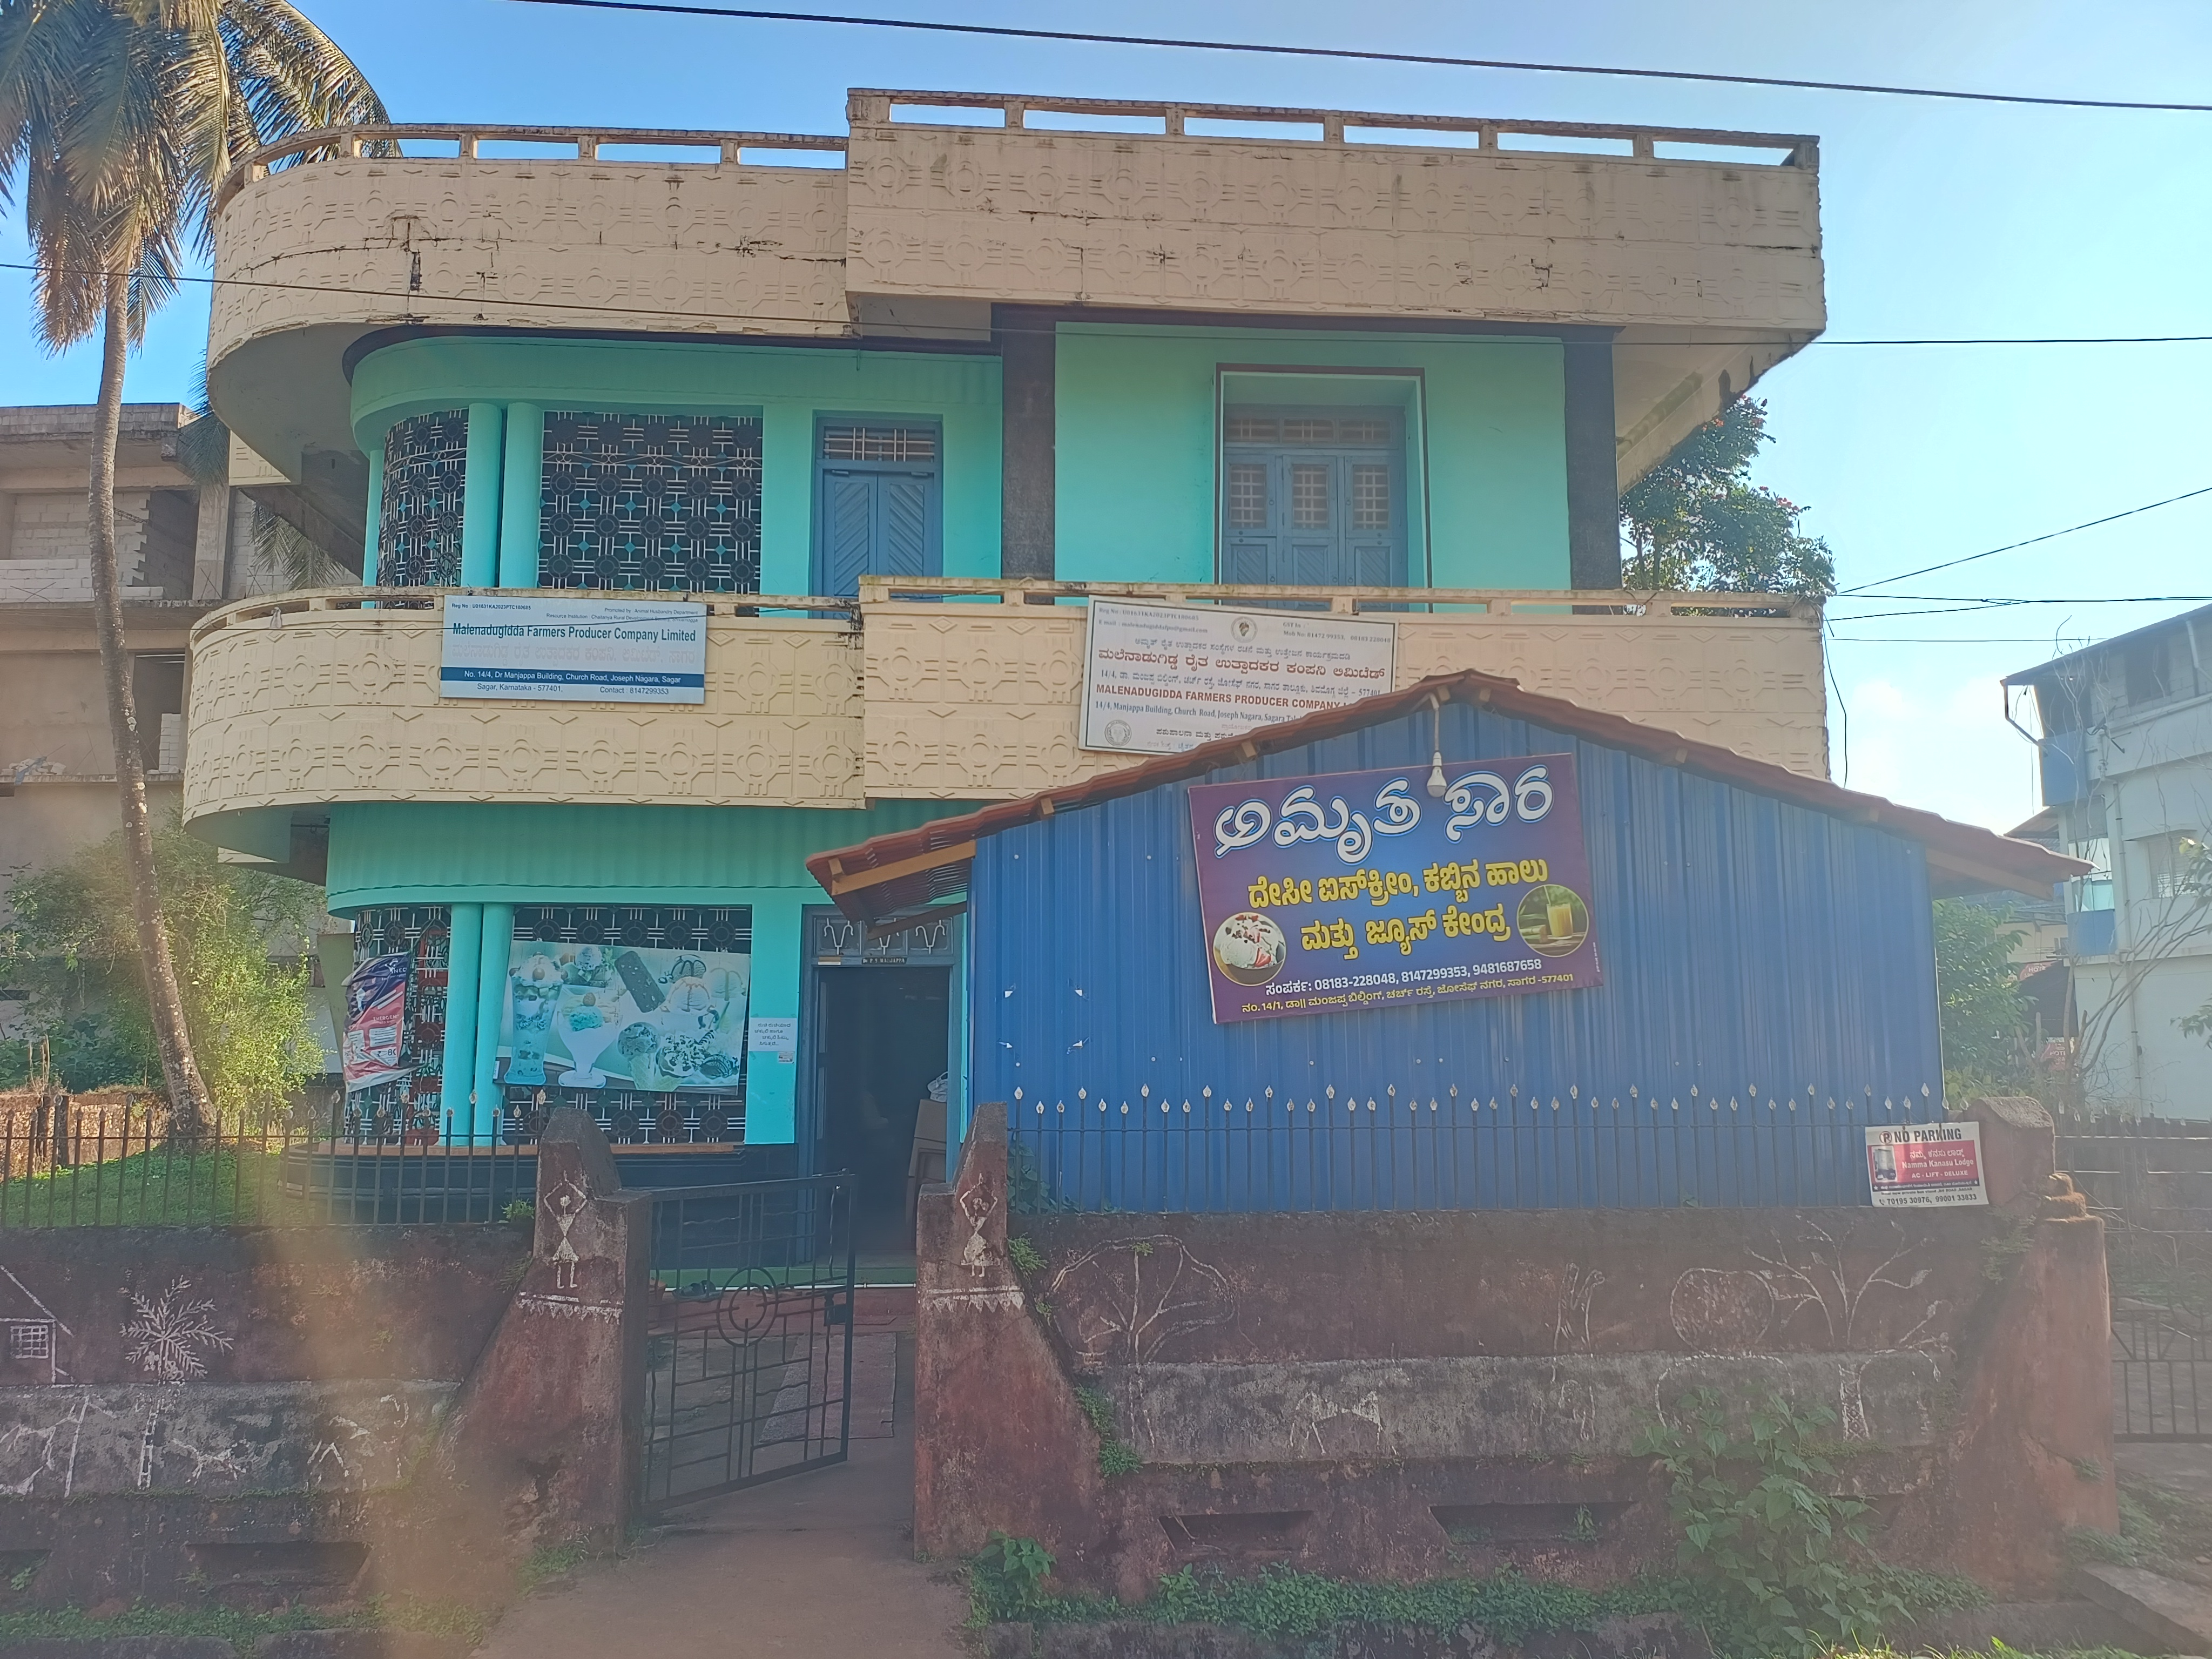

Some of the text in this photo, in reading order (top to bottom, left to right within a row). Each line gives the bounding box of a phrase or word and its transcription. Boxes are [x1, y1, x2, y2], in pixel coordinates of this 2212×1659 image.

[527, 625, 565, 638] Farmers
[569, 626, 612, 639] Producer
[614, 627, 659, 643] Company
[662, 629, 696, 642] Limited
[1098, 648, 1178, 670] ಮಲೆನಾಡುಗಿಡ್ಡ
[1185, 654, 1209, 672] ರೈತ
[1215, 658, 1279, 675] ಉತ್ಪಾದಕರ
[1286, 662, 1326, 676] ಕಂಪನಿ
[464, 670, 476, 678] No.
[478, 670, 493, 679] 14/4,
[504, 671, 535, 680] Manjappa
[537, 672, 564, 682] Building,
[565, 673, 589, 681] Church
[590, 673, 609, 682] Road,
[610, 675, 634, 684] Joseph
[635, 675, 660, 684] Nagara,
[662, 676, 682, 685] Sagar
[477, 683, 497, 691] Sagar,
[1096, 684, 1341, 710] MALENADUGIDDA FARMERS PRODUCER COMPANY
[1113, 703, 1144, 713] Manjappa
[1145, 704, 1174, 716] Building,
[1174, 705, 1197, 716] Church
[1199, 708, 1216, 718] Road,
[1217, 709, 1239, 720] Joseph
[1239, 711, 1264, 722] Nagara,
[1214, 764, 1554, 865] ಅಮೃತ ಸಾರ
[1422, 859, 1481, 903] ಕಬ್ಬಿನ
[1485, 859, 1549, 887] ಹಾಲು
[1300, 917, 1359, 960] ಮತ್ತು
[1441, 903, 1512, 942] ಕೇಂದ್ರ
[1314, 973, 1399, 991] 08183-228048,
[1401, 965, 1471, 983] 8147299353,
[1473, 958, 1542, 975] 9481687658
[1507, 975, 1536, 987] ಸಾಗರ
[1894, 1128, 1963, 1143] NO PARKING
[1928, 1159, 1953, 1168] Kanasu
[1954, 1158, 1974, 1166] Lodge
[1909, 1196, 1932, 1204] 30976,
[1957, 1193, 1977, 1202] 33833
